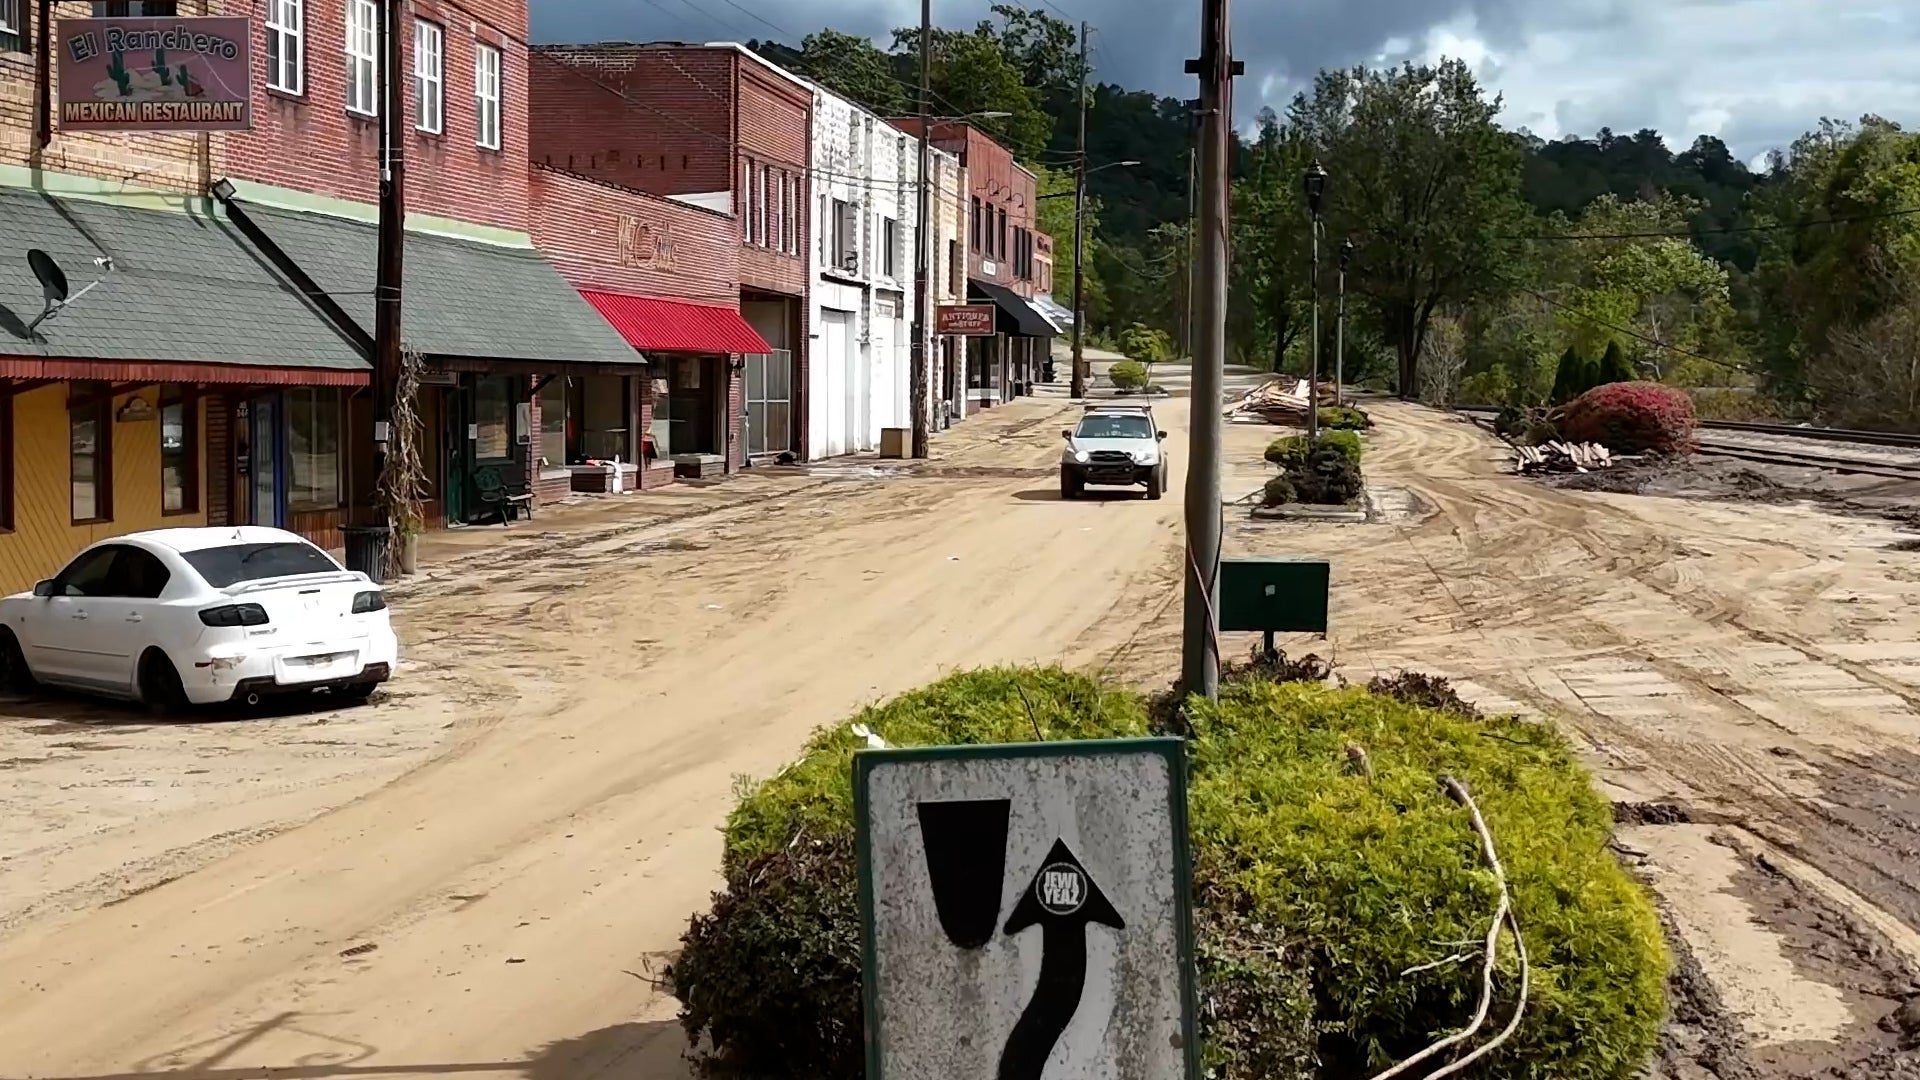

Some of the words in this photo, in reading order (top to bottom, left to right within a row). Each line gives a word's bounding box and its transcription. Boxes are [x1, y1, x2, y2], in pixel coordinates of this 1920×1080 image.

[67, 32, 98, 62] El
[104, 25, 238, 60] Ranchero
[64, 101, 136, 122] MEXICAN
[142, 101, 244, 122] RESTAURANT
